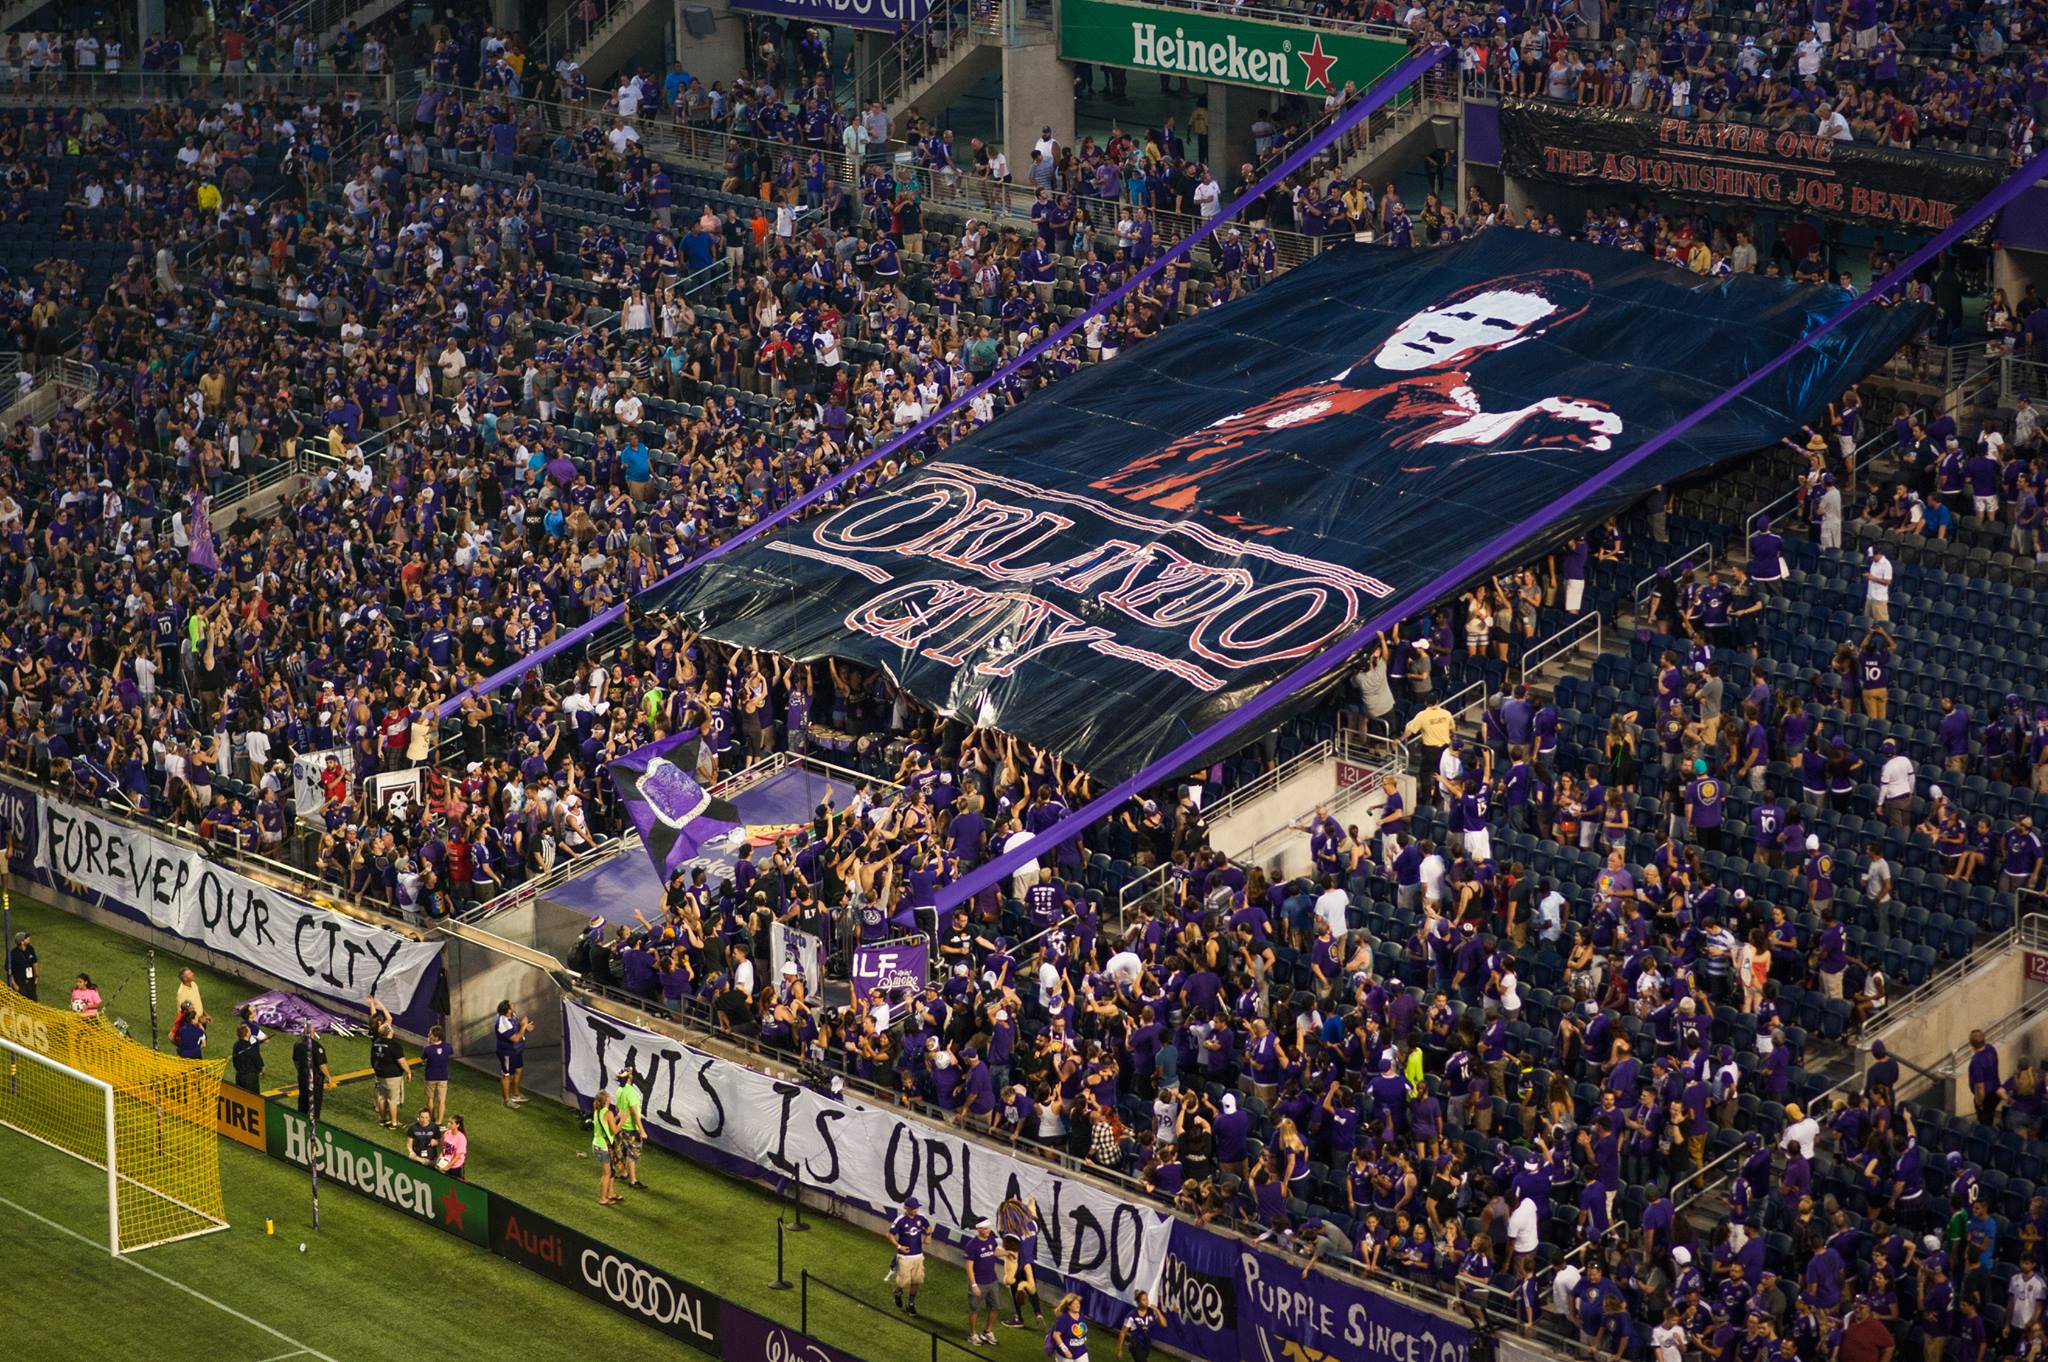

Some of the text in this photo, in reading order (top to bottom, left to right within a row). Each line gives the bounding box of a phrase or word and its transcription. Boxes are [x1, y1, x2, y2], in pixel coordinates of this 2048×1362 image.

[1132, 22, 1290, 86] Heineken
[1659, 117, 1836, 163] PLAYER ONE
[1543, 146, 1958, 230] THE ASTONISHING JOE BENDIK
[844, 580, 1115, 678] CITY
[1864, 666, 1881, 681] 10
[1760, 815, 1776, 833] 10
[199, 870, 275, 947] OUR
[296, 914, 401, 997] CITY
[853, 953, 898, 978] ILF
[586, 1014, 725, 1139] THIS
[767, 1081, 845, 1183] IS
[283, 1112, 435, 1219] Heineken
[504, 1215, 714, 1341] Audi GOOOOAL
[1241, 1252, 1335, 1337] PURPLE
